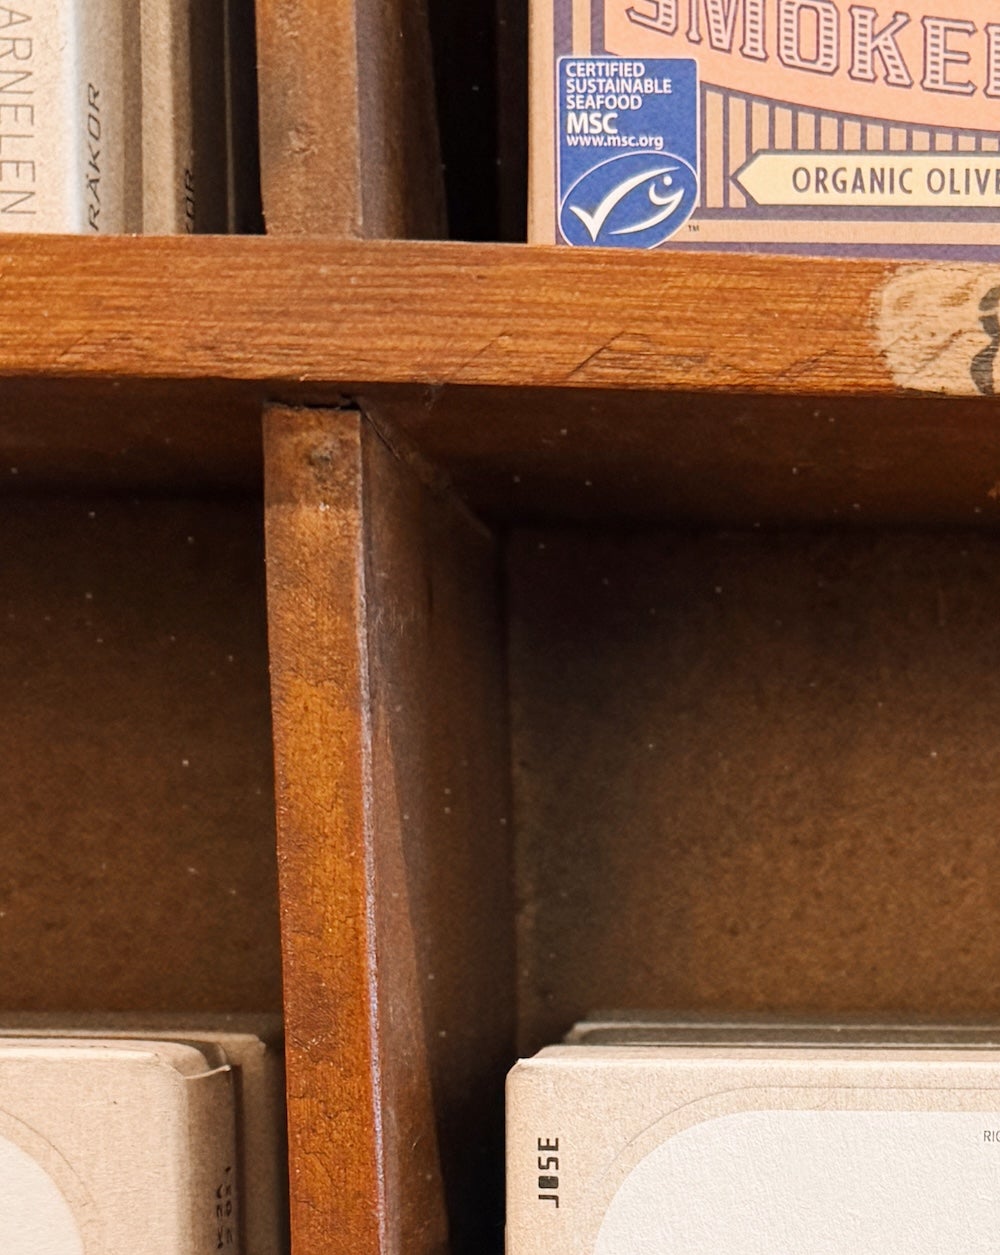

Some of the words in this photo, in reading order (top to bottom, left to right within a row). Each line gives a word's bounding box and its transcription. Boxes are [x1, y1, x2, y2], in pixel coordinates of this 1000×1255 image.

[566, 62, 645, 77] CERTIFIED
[566, 79, 672, 94] SUSTAINABLE
[566, 95, 643, 110] SEAFOOD
[567, 112, 618, 134] MSC
[566, 135, 664, 150] www.msc.org
[86, 83, 101, 231] RÄKOR
[792, 167, 913, 194] ORGANIC
[538, 1137, 559, 1209] JOSE
